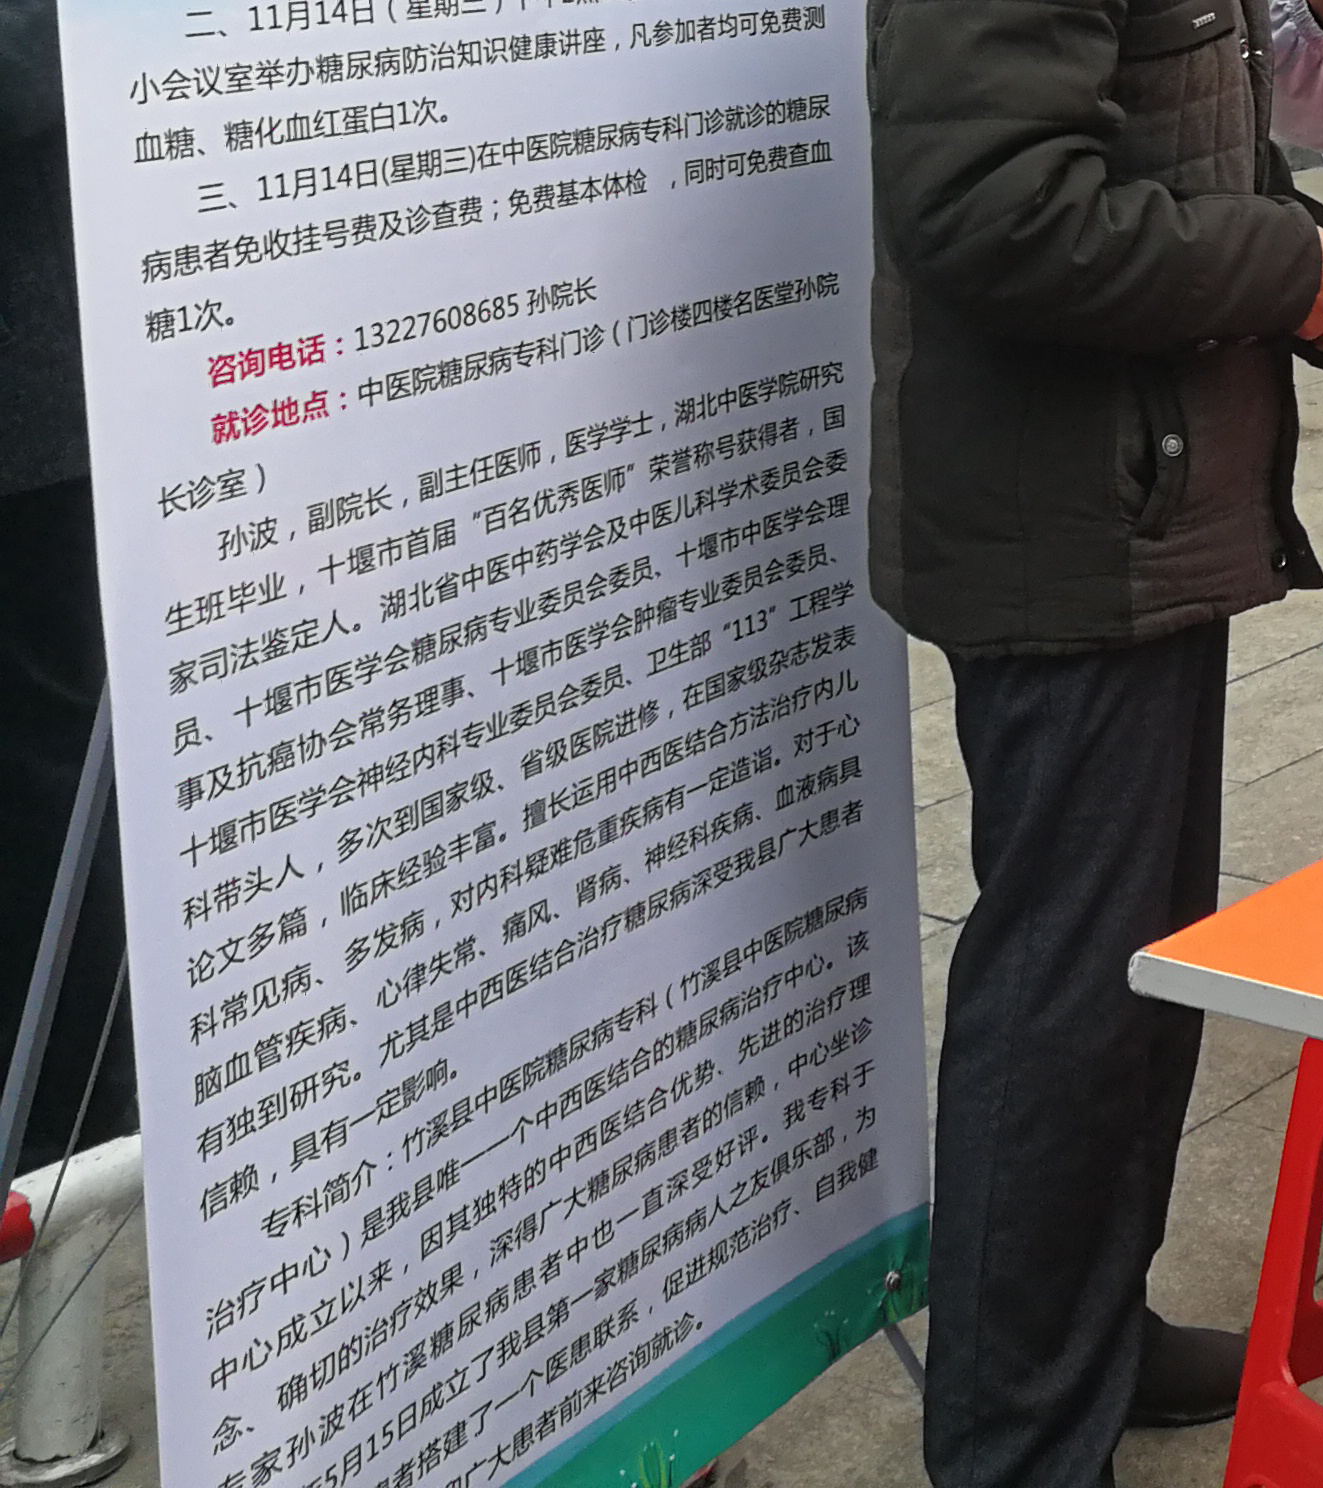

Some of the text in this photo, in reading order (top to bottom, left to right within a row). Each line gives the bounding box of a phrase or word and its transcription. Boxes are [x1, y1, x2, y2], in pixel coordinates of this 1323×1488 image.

[526, 275, 598, 317] 孙院长
[144, 298, 235, 343] 糖1次。
[157, 462, 266, 519] 长诊室）
